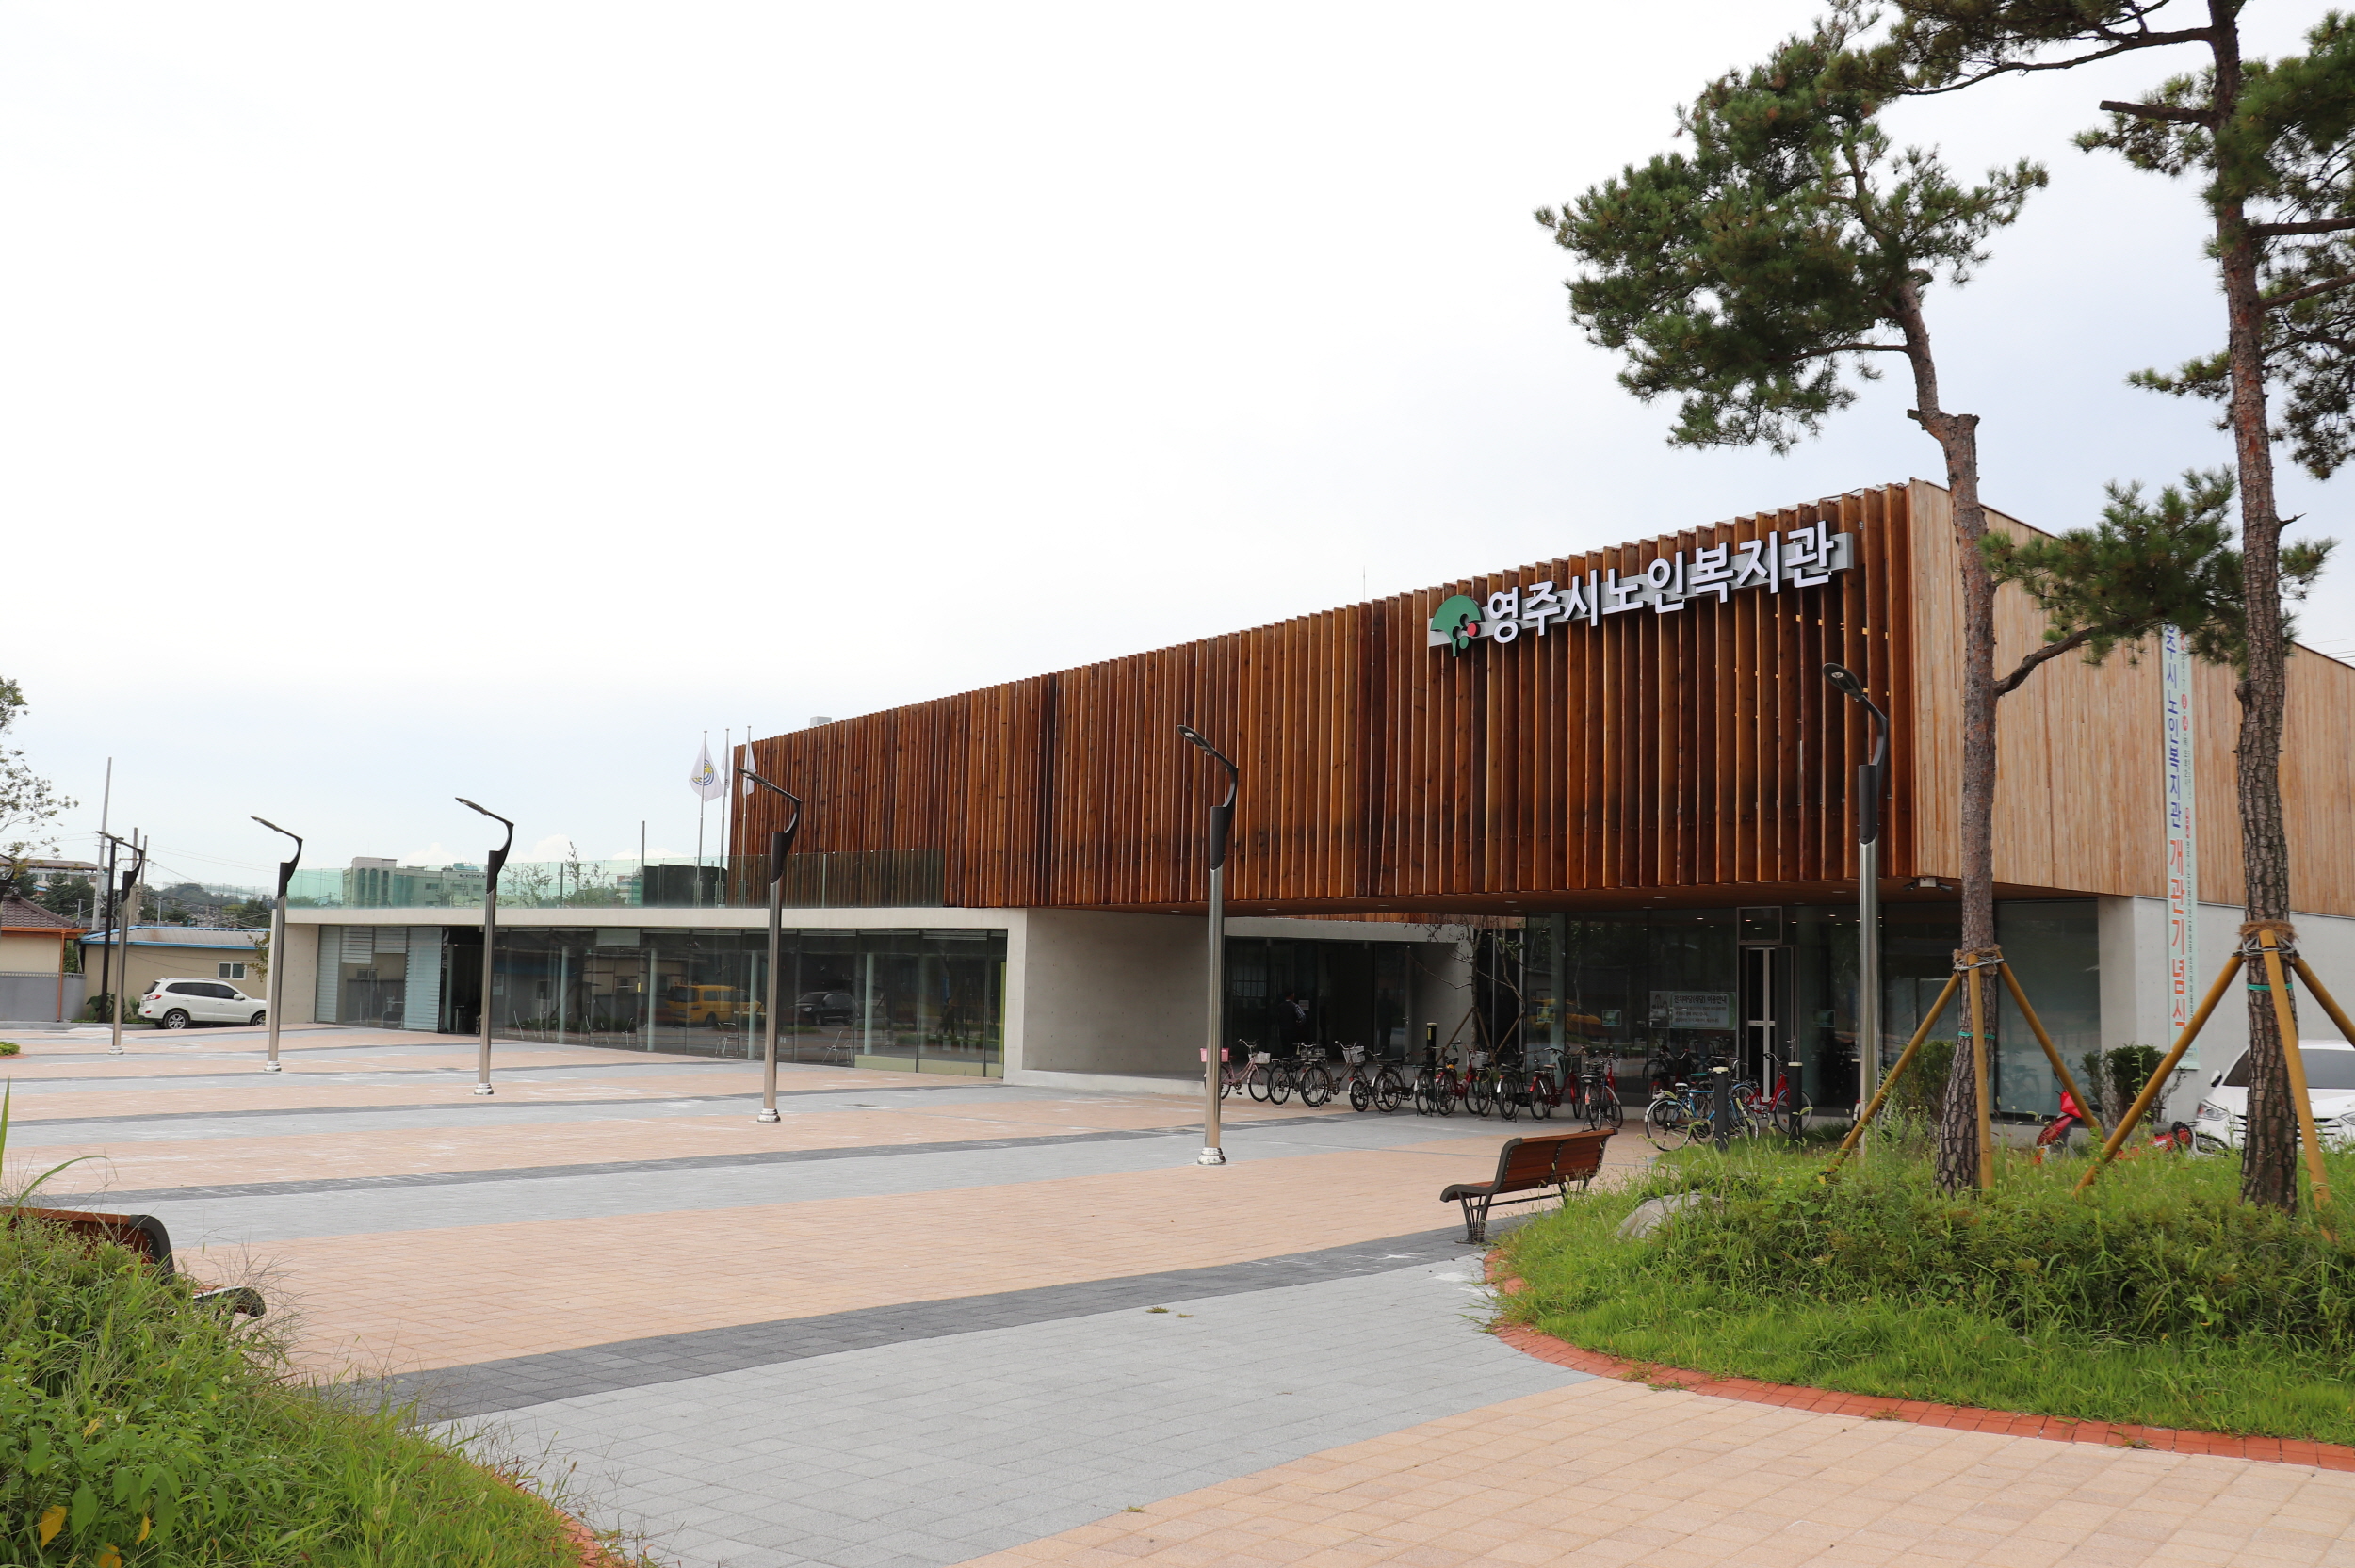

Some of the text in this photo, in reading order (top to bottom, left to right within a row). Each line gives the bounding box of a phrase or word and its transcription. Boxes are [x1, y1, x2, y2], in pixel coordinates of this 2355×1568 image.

[1486, 520, 1836, 644] 영주시노인복지관
[2169, 838, 2186, 1031] 개관기념식
[1707, 994, 1727, 1005] 이용안내
